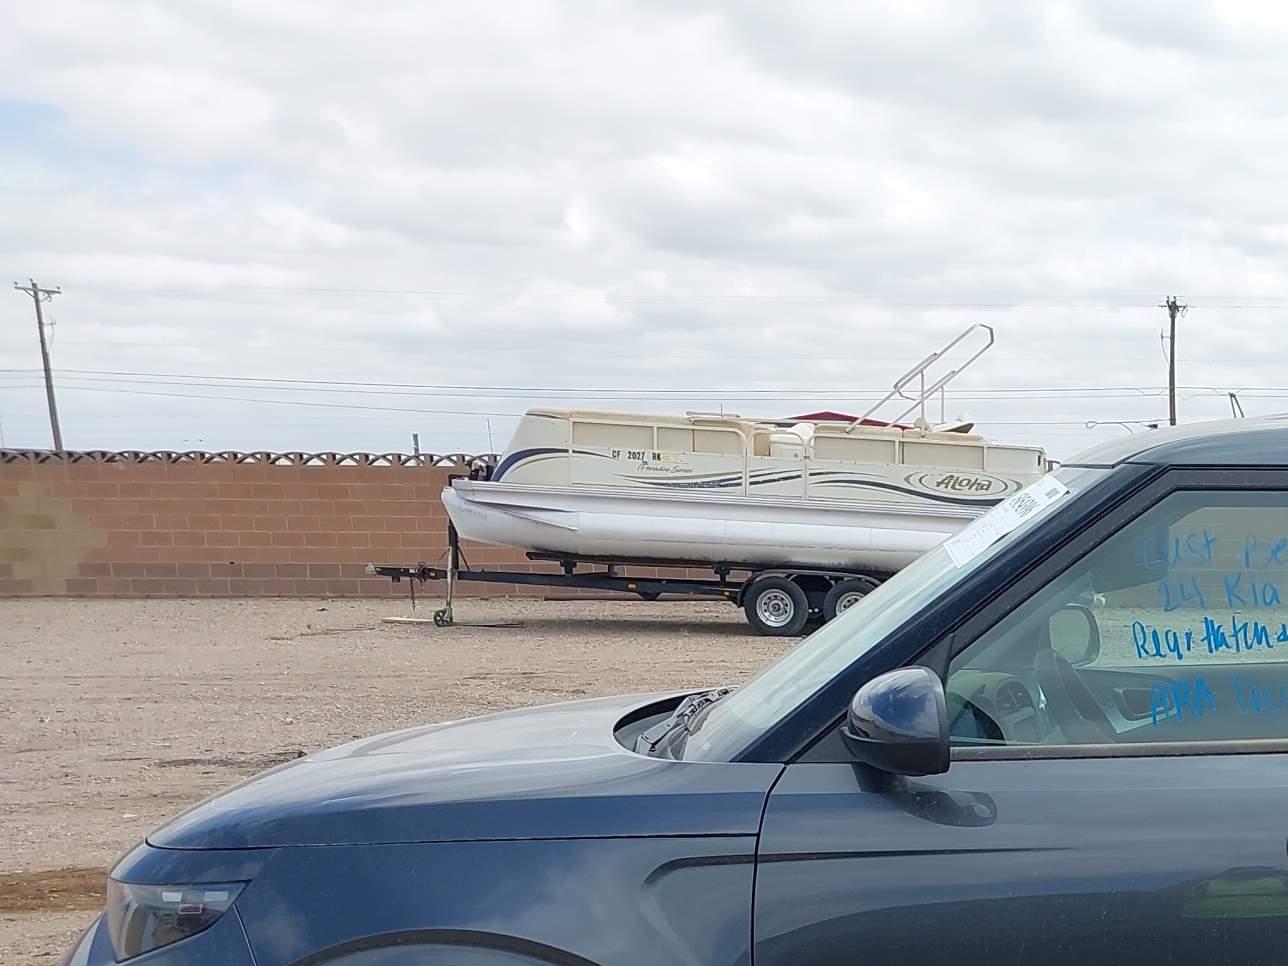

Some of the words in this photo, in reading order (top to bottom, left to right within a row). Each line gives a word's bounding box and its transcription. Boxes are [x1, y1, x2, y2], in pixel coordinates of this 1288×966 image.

[611, 450, 621, 458] CF
[627, 451, 645, 461] 2027
[1224, 571, 1281, 609] Kia
